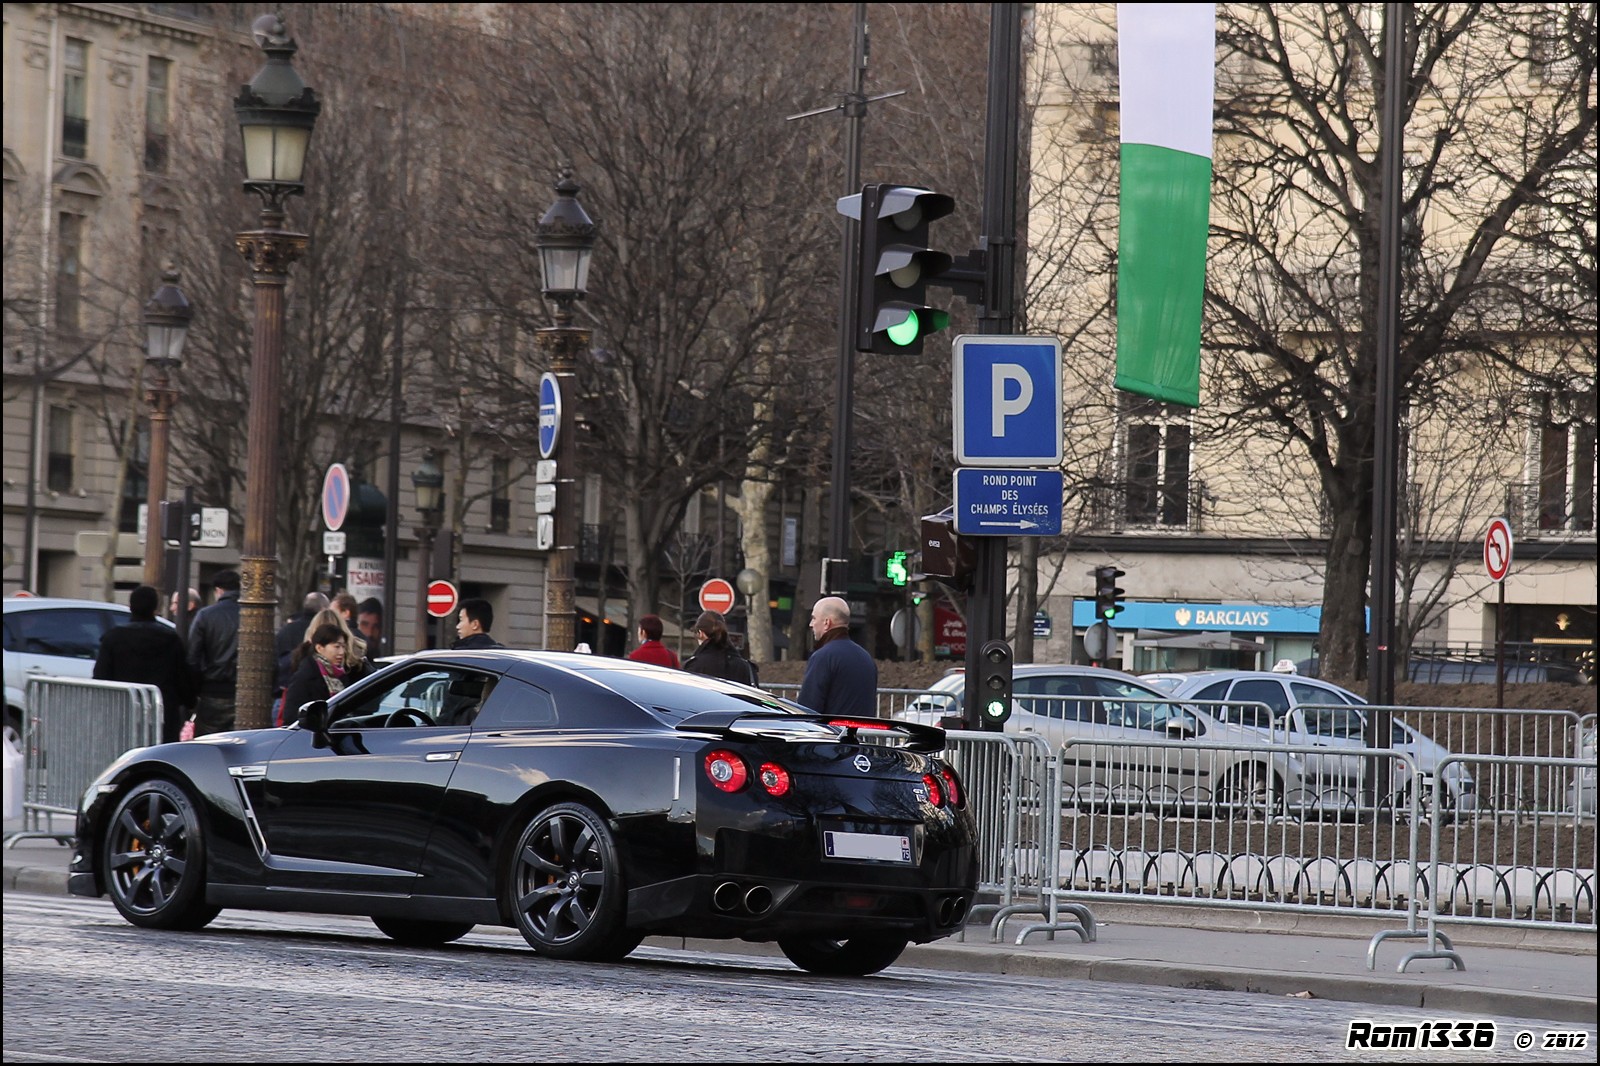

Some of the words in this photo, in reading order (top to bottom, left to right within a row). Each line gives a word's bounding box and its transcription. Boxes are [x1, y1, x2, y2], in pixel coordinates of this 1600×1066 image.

[992, 363, 1034, 438] P
[983, 475, 1008, 486] ROND
[1011, 475, 1037, 487] POINT
[1001, 490, 1019, 501] DES
[971, 503, 1008, 515] CHAMPS
[1012, 502, 1049, 515] ÉLYSÉES
[1195, 609, 1270, 626] BARCLAYS
[902, 849, 910, 860] 75
